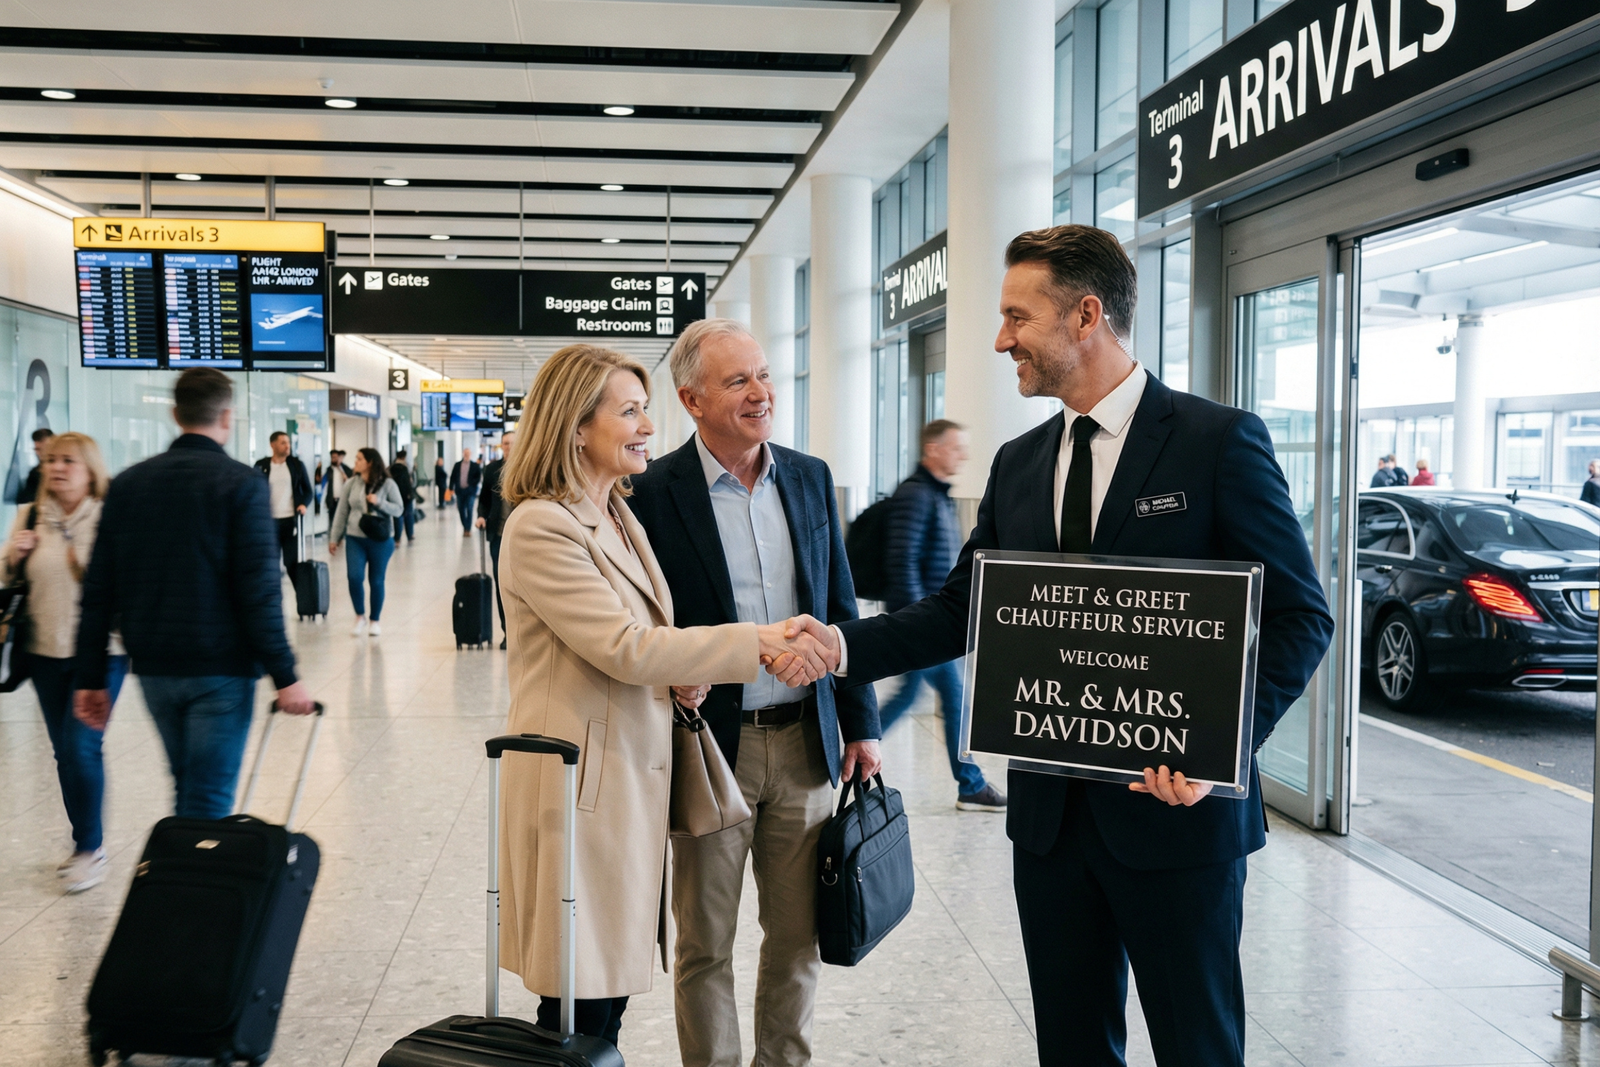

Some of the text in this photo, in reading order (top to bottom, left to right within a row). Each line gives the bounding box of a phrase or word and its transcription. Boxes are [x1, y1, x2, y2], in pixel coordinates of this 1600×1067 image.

[1148, 79, 1203, 137] Terminal
[1168, 134, 1183, 189] 3
[128, 225, 219, 243] Arrivals 3
[252, 276, 270, 285] LHR
[280, 267, 319, 277] LONDON
[387, 272, 430, 287] Gates
[610, 277, 652, 291] Gates
[545, 296, 652, 314] Baggage Claim
[890, 292, 896, 320] 3
[577, 318, 652, 332] Restrooms
[392, 370, 406, 389] 3
[1029, 584, 1190, 611] MEET & GREET
[996, 606, 1225, 640] CHAUFFEUR SERVICE
[1059, 648, 1149, 671] WELCOME
[1014, 677, 1191, 719] MR. & MRS.
[1013, 710, 1189, 755] DAVIDSON
